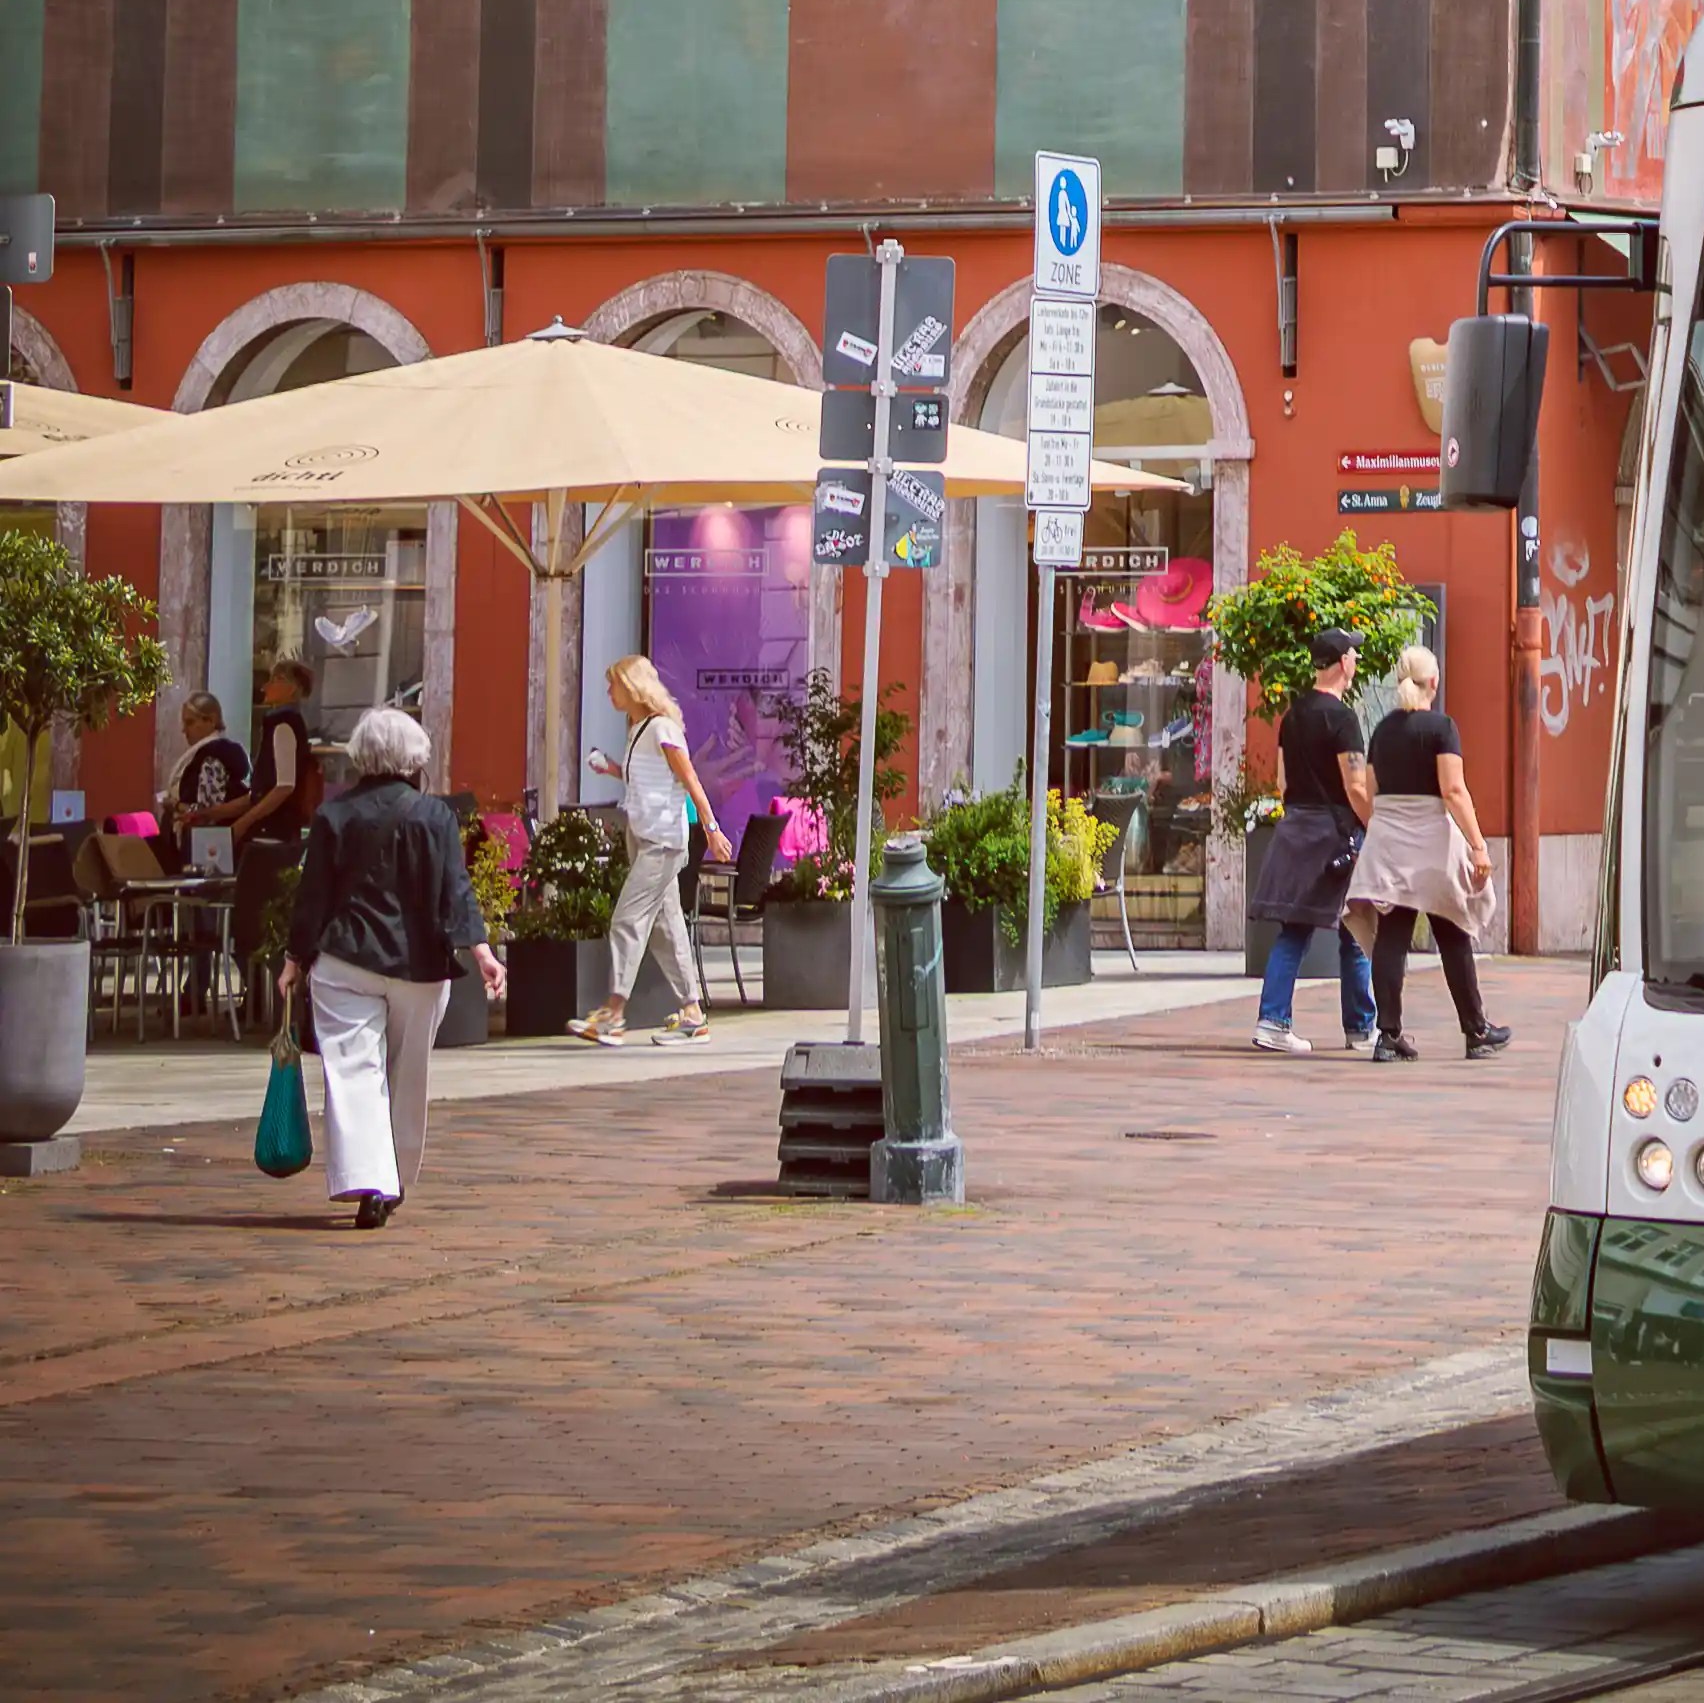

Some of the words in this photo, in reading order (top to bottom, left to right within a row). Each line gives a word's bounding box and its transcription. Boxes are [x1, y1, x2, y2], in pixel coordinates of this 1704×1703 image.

[1051, 261, 1082, 285] ZONE
[1364, 493, 1388, 507] Anna
[277, 561, 379, 574] WERDICH
[654, 556, 761, 569] WERH
